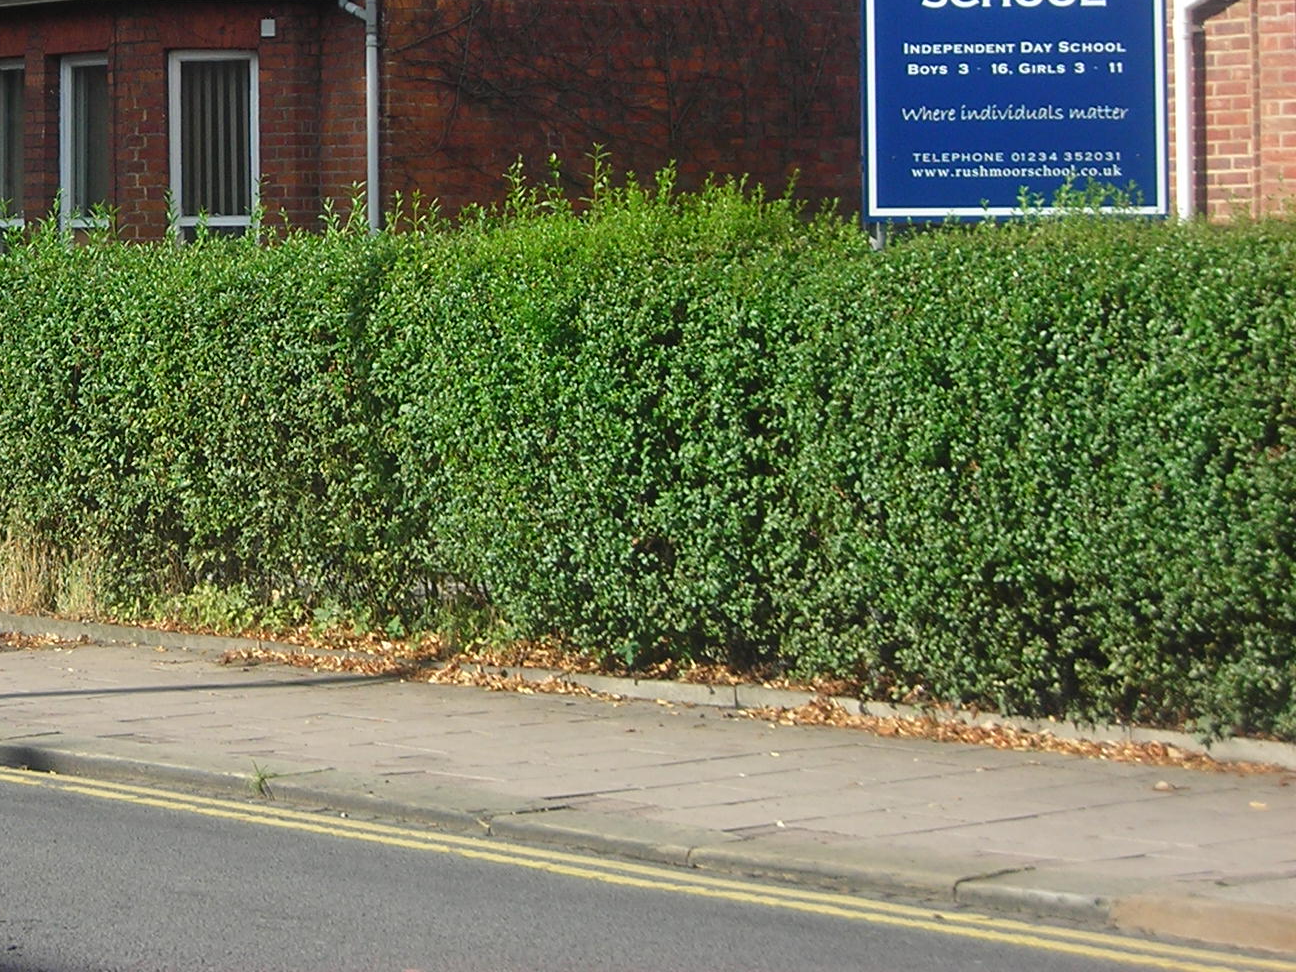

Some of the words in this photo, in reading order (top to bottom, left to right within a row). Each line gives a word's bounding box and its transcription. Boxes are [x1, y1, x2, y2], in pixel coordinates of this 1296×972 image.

[903, 42, 1015, 54] INDEPENDENT
[1020, 41, 1053, 54] DAY
[1058, 41, 1126, 53] SCHOOL
[907, 63, 948, 75] BOYS
[958, 63, 969, 75] 3
[1018, 62, 1066, 74] GIRLS
[1074, 62, 1085, 74] 3
[1108, 62, 1123, 74] 11
[902, 105, 956, 121] Where
[960, 104, 1064, 120] individuals
[1069, 104, 1129, 120] matter
[912, 152, 1004, 162] TELEPHONE
[1011, 152, 1058, 162] 01234
[1063, 151, 1121, 162] 352031
